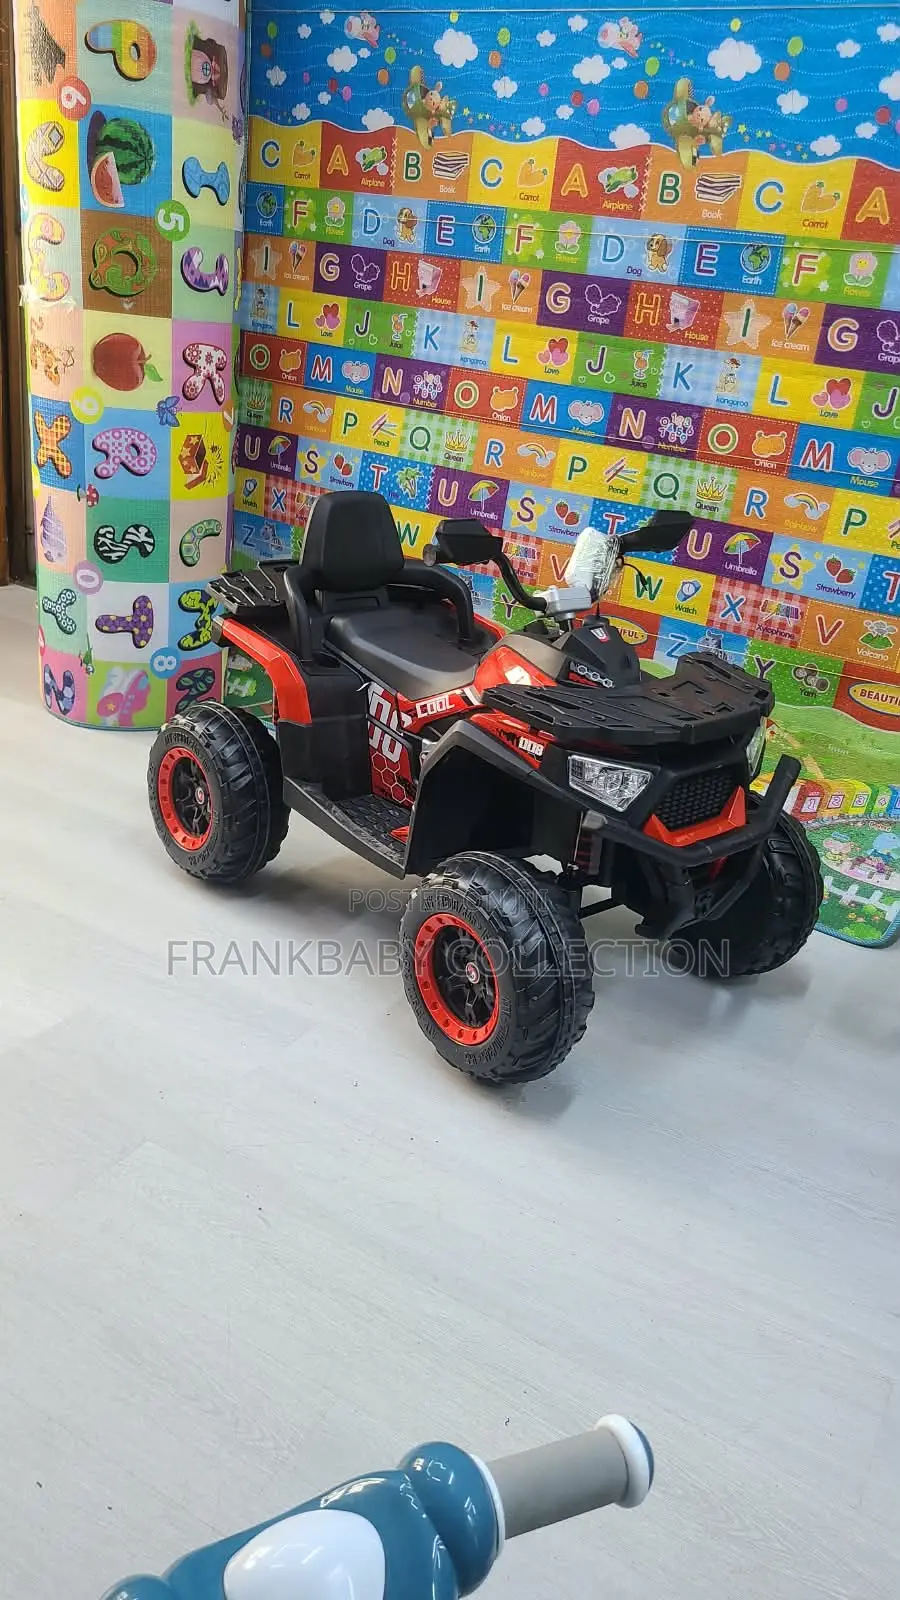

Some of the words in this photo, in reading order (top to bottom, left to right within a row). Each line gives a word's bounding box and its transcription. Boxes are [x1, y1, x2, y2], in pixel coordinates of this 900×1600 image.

[85, 19, 157, 81] P
[61, 86, 87, 109] 6
[261, 140, 280, 168] C
[327, 145, 349, 176] A
[404, 151, 422, 182] B
[294, 171, 311, 180] Carrot
[361, 177, 386, 188] Airplane
[480, 159, 503, 189] C
[561, 163, 588, 198] A
[439, 184, 456, 194] Book
[519, 192, 540, 202] Carrot
[658, 171, 681, 206] B
[754, 180, 784, 214] C
[291, 200, 309, 227] F
[602, 200, 633, 212] Airplane
[702, 209, 723, 220] Book
[855, 187, 890, 225] A
[158, 209, 185, 232] 5
[259, 220, 273, 228] Earth
[362, 207, 381, 236] D
[436, 215, 456, 246] E
[802, 218, 829, 230] Carrot
[383, 237, 395, 247] Dog
[474, 244, 490, 254] Earth
[514, 225, 535, 255] F
[601, 233, 625, 264] D
[263, 246, 270, 271] I
[319, 252, 340, 282] G
[695, 243, 720, 276] E
[792, 253, 820, 286] F
[180, 247, 229, 296] J
[390, 262, 411, 291] H
[626, 266, 642, 277] Dog
[742, 275, 762, 286] Earth
[354, 280, 373, 292] Grape
[476, 272, 484, 302] I
[545, 282, 572, 314] G
[431, 296, 452, 305] House
[502, 303, 511, 311] Ice
[512, 305, 533, 313] cream
[635, 292, 662, 326] H
[286, 301, 300, 328] L
[354, 311, 371, 337] J
[588, 314, 610, 325] Grape
[742, 308, 750, 337] I
[320, 329, 333, 338] Love
[389, 340, 403, 348] Juice
[424, 324, 441, 352] K
[684, 331, 709, 341] House
[771, 339, 783, 348] Ice
[784, 341, 810, 351] cream
[827, 318, 860, 352] G
[250, 344, 270, 370] O
[502, 335, 519, 364] L
[586, 346, 607, 375] J
[878, 352, 900, 364] Grap
[182, 343, 227, 406] K
[282, 372, 297, 381] Onion
[311, 355, 332, 383] M
[382, 367, 404, 395] N
[544, 367, 560, 375] Love
[672, 362, 694, 391] K
[345, 385, 364, 394] Mouse
[454, 380, 479, 409] O
[630, 378, 648, 389] Juice
[769, 374, 790, 406] L
[278, 397, 294, 424] R
[413, 397, 437, 408] Number
[530, 393, 558, 425] M
[716, 395, 749, 408] kangaroo
[819, 409, 838, 419] Love
[872, 387, 899, 419] J
[342, 412, 358, 435] P
[492, 412, 511, 422] Onion
[619, 408, 646, 439] N
[374, 438, 390, 448] Pencil
[409, 426, 432, 451] Q
[572, 426, 596, 437] Mouse
[707, 424, 739, 455] O
[34, 410, 72, 479] X
[92, 427, 157, 479] R
[245, 434, 260, 460] U
[485, 439, 505, 468] R
[801, 439, 834, 473] M
[270, 462, 291, 473] Umbrella
[304, 450, 319, 474] S
[444, 453, 464, 463] Queen
[567, 455, 588, 481] P
[754, 459, 777, 470] Onion
[330, 476, 354, 488] Strawberry
[372, 464, 388, 489] T
[653, 472, 680, 501] Q
[851, 476, 879, 488] Mouse
[272, 488, 287, 512] X
[437, 478, 458, 507] U
[608, 485, 628, 496] Pencil
[744, 487, 769, 519] R
[243, 500, 257, 509] Watch
[470, 509, 498, 520] Umbrella
[517, 497, 537, 523] S
[695, 501, 719, 513] Queen
[397, 521, 419, 546] W
[603, 512, 626, 536] T
[841, 507, 868, 536] P
[94, 524, 155, 564] S
[242, 525, 255, 547] Z
[686, 529, 713, 560] U
[551, 554, 570, 582] V
[724, 561, 758, 576] Umbrella
[779, 551, 802, 580] S
[635, 574, 663, 600] W
[815, 583, 856, 599] Strawberry
[42, 589, 77, 634] Y
[501, 594, 518, 619] Y
[675, 604, 697, 615] Watch
[720, 593, 746, 622] X
[95, 595, 153, 648] T
[756, 623, 795, 639] Xylophone
[816, 614, 844, 645] V
[665, 633, 688, 658] Z
[857, 648, 888, 661] Volcano
[153, 656, 177, 673] 8
[754, 656, 776, 680] Y
[799, 687, 816, 699] Yarn
[416, 695, 455, 718] COOL
